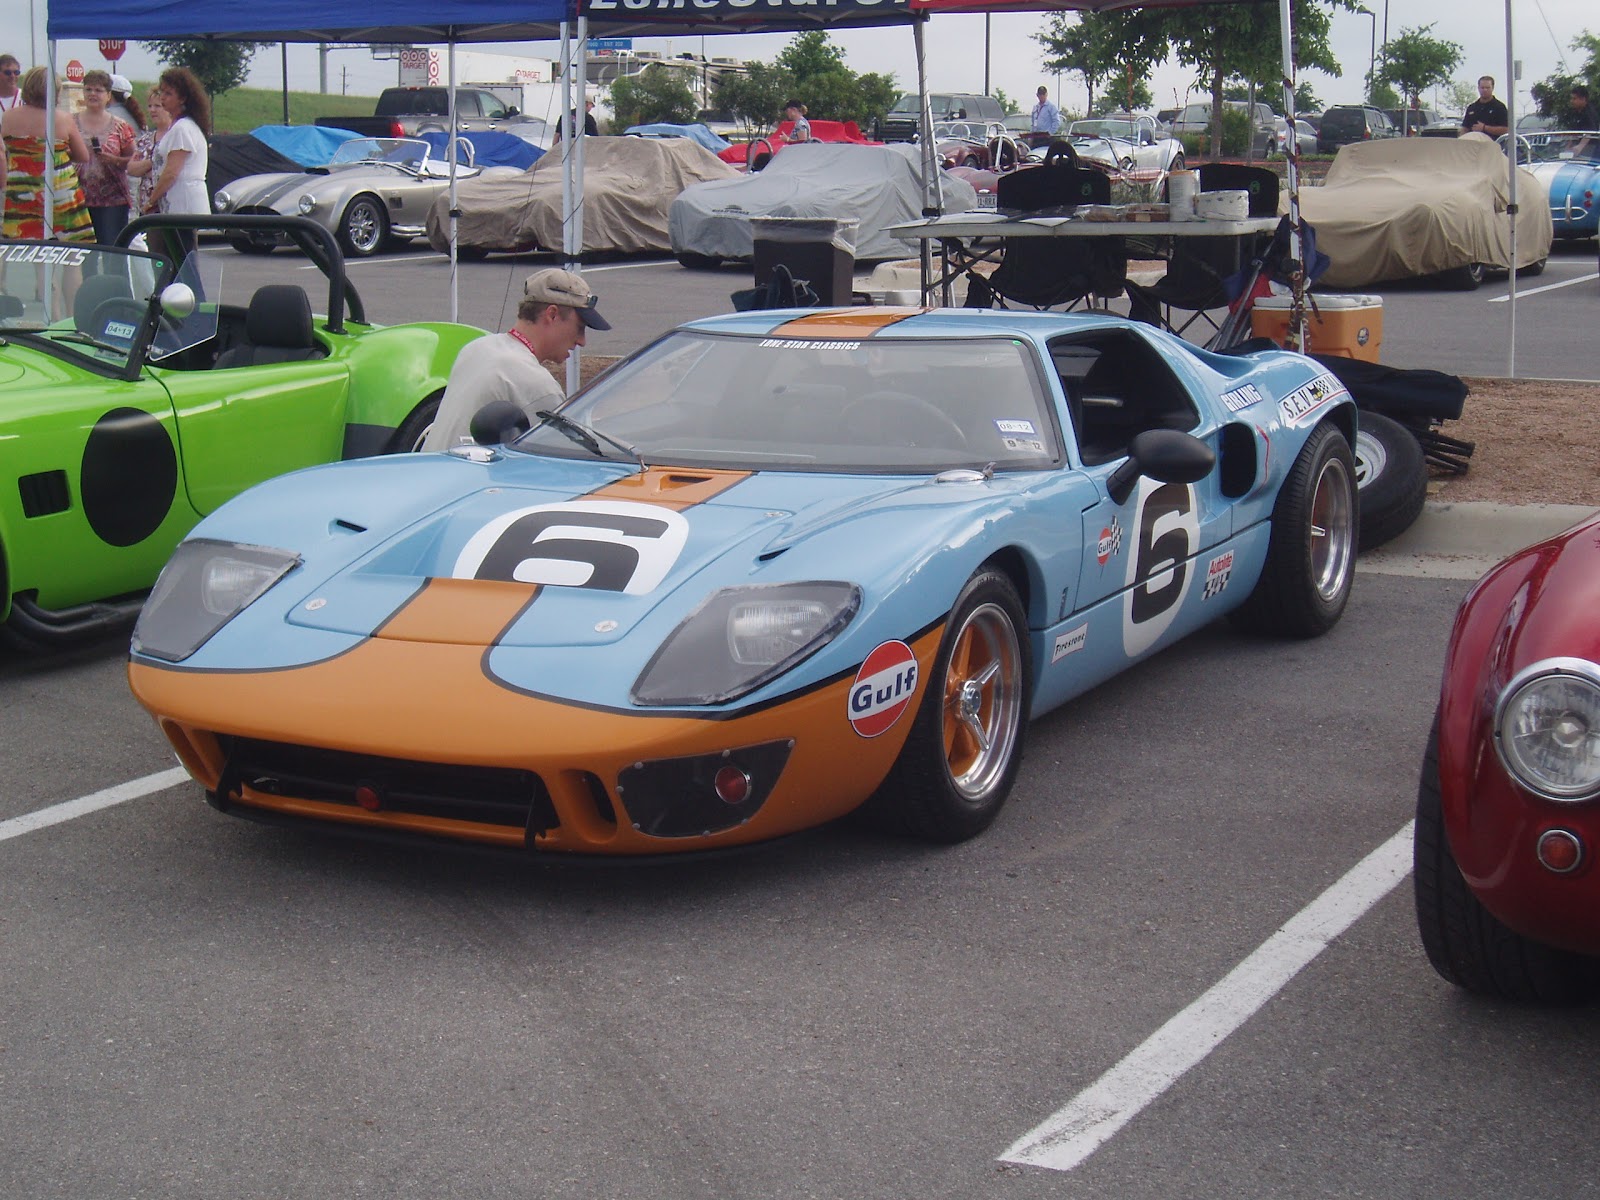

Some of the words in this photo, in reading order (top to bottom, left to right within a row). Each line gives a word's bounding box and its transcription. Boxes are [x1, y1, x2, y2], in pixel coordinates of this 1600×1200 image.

[100, 39, 123, 50] STOP
[67, 67, 83, 77] STOP
[402, 62, 427, 70] TARGET
[521, 71, 541, 79] TARGET
[5, 245, 92, 266] CLASSICS
[759, 339, 784, 348] LONE
[783, 341, 810, 349] STAR
[809, 342, 860, 350] CLASSICS
[474, 511, 669, 592] 6
[1131, 482, 1191, 624] 6
[1209, 553, 1233, 576] Autolite
[1055, 633, 1085, 656] Firestone
[851, 666, 916, 713] Gulf
